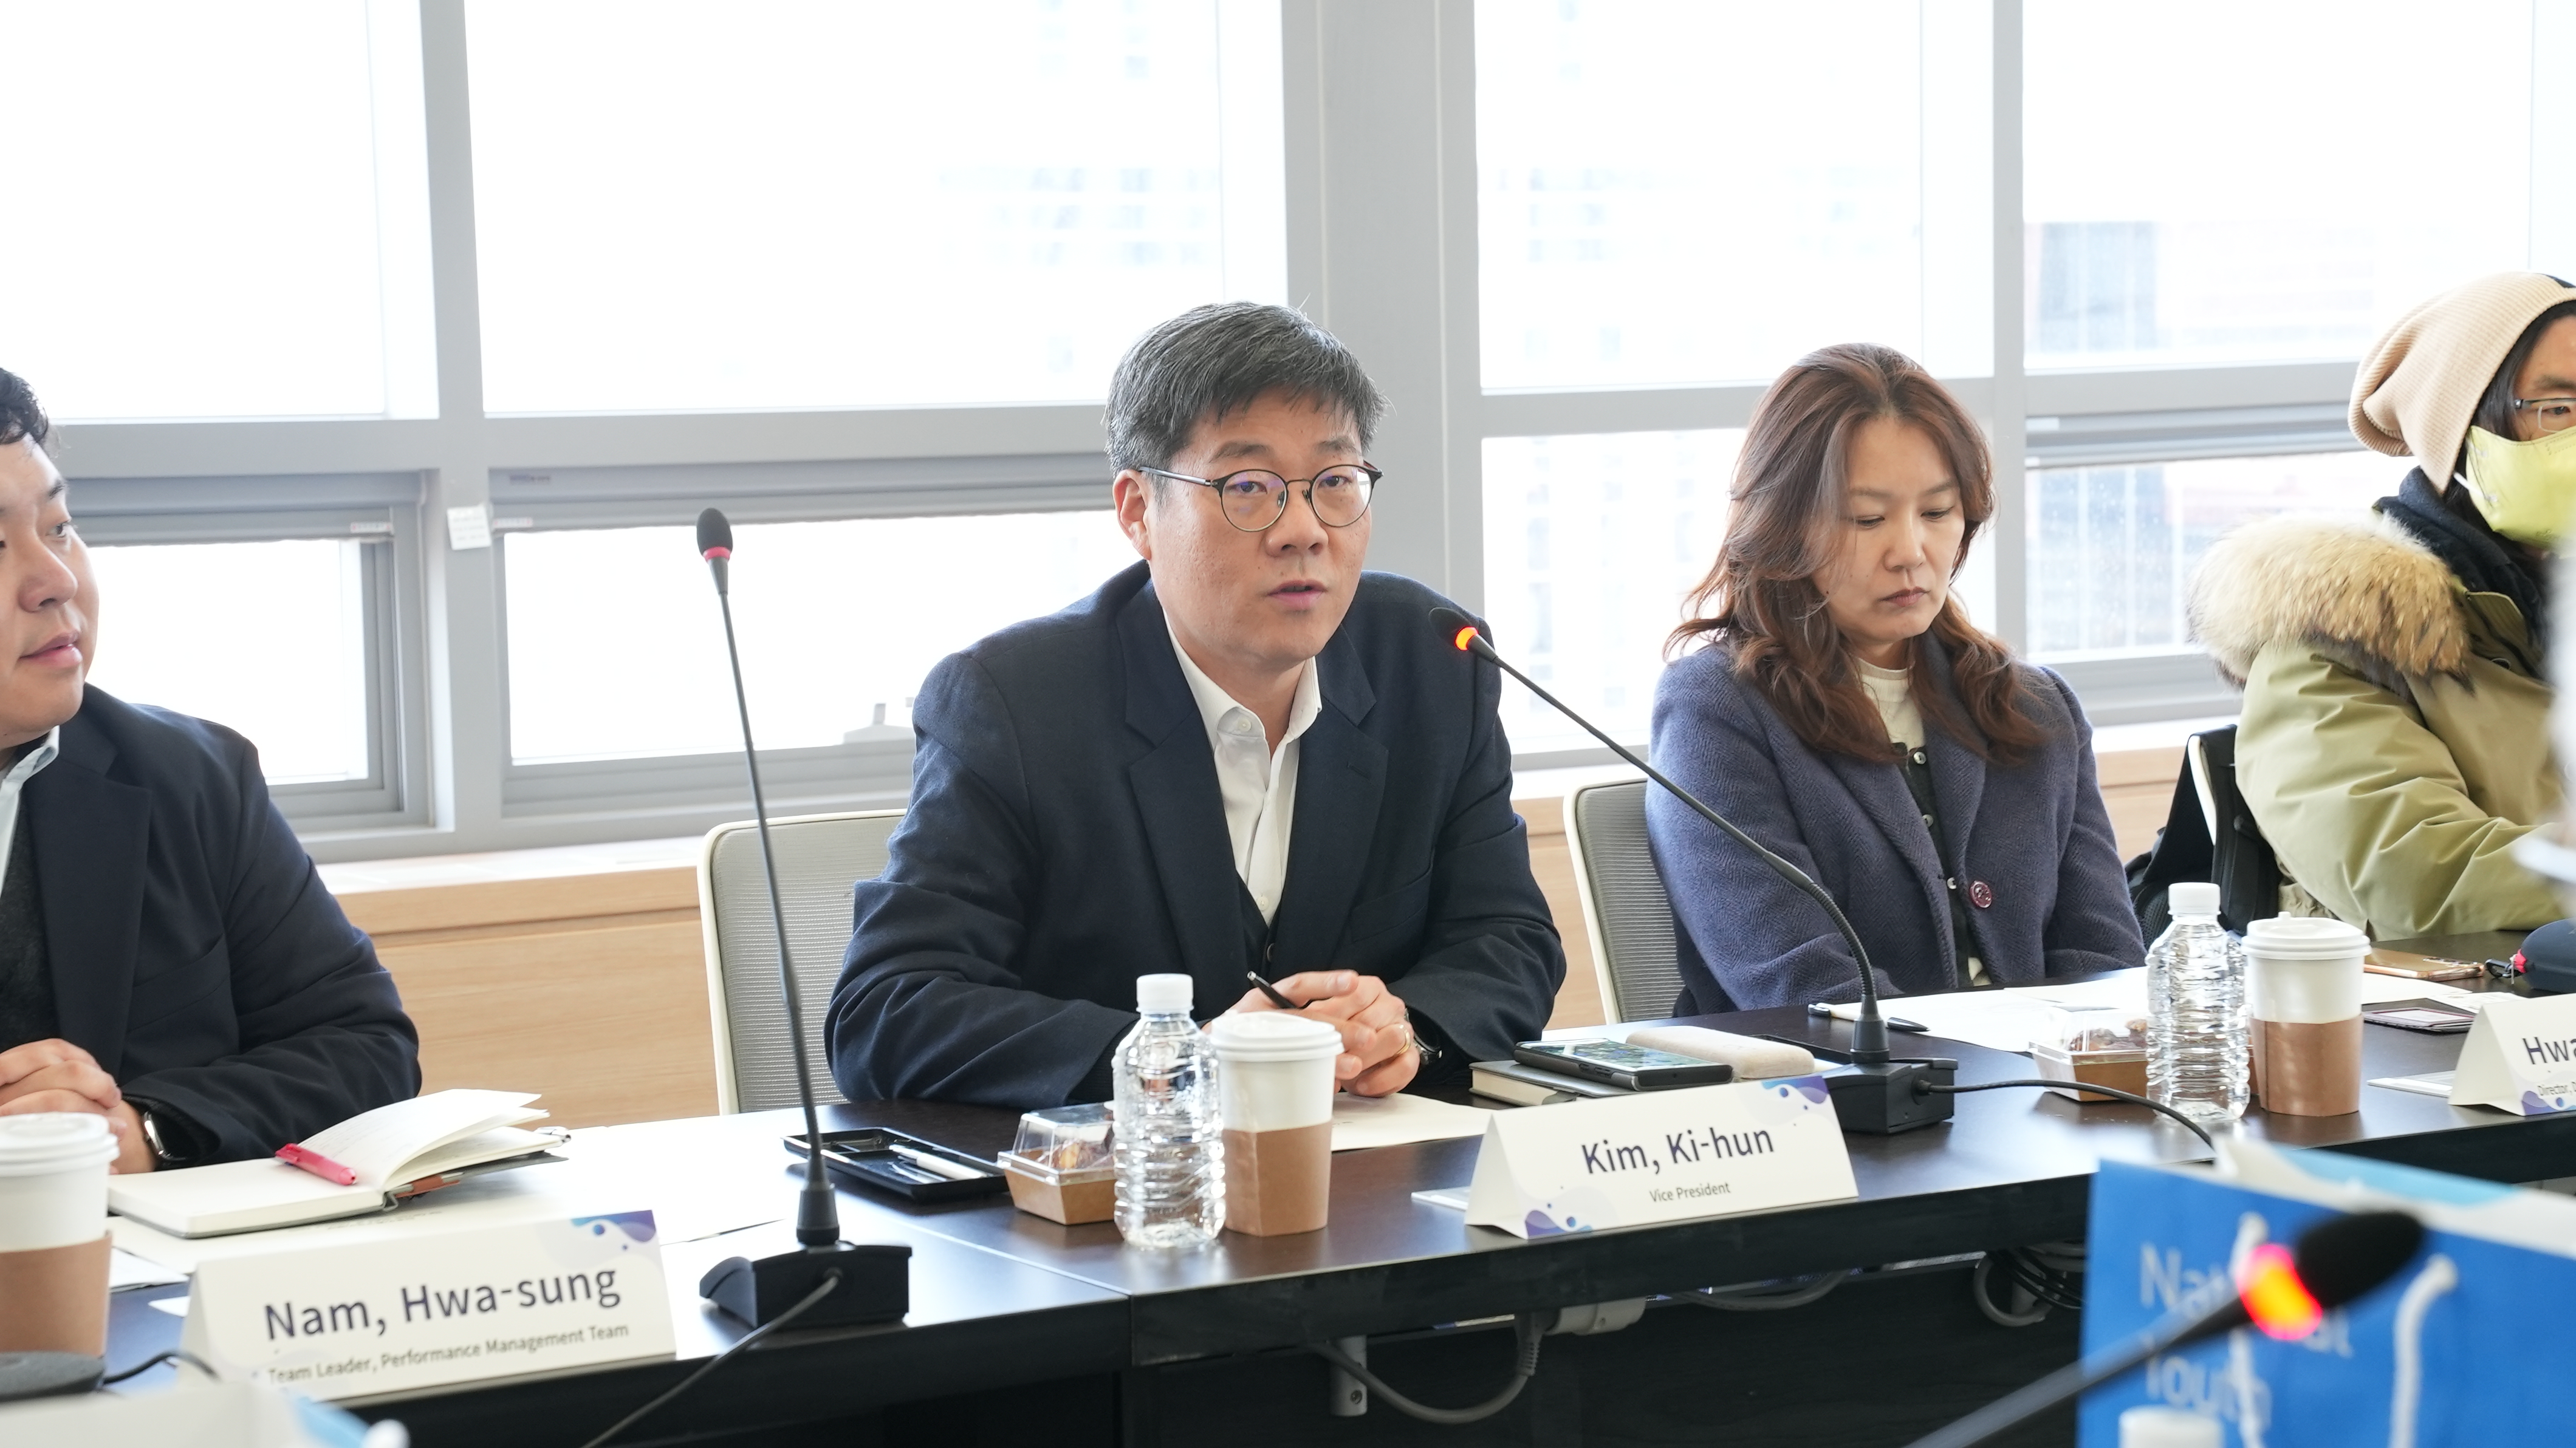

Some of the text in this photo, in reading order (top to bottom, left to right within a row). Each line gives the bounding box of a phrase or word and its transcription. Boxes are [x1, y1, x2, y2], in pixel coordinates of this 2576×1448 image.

[1581, 1127, 1774, 1174] Kim, Ki-hun
[1649, 1182, 1731, 1202] Vice President
[265, 1269, 621, 1340] Nam, Hwa-sung
[267, 1325, 629, 1384] Team Leader, Performance Management Team
